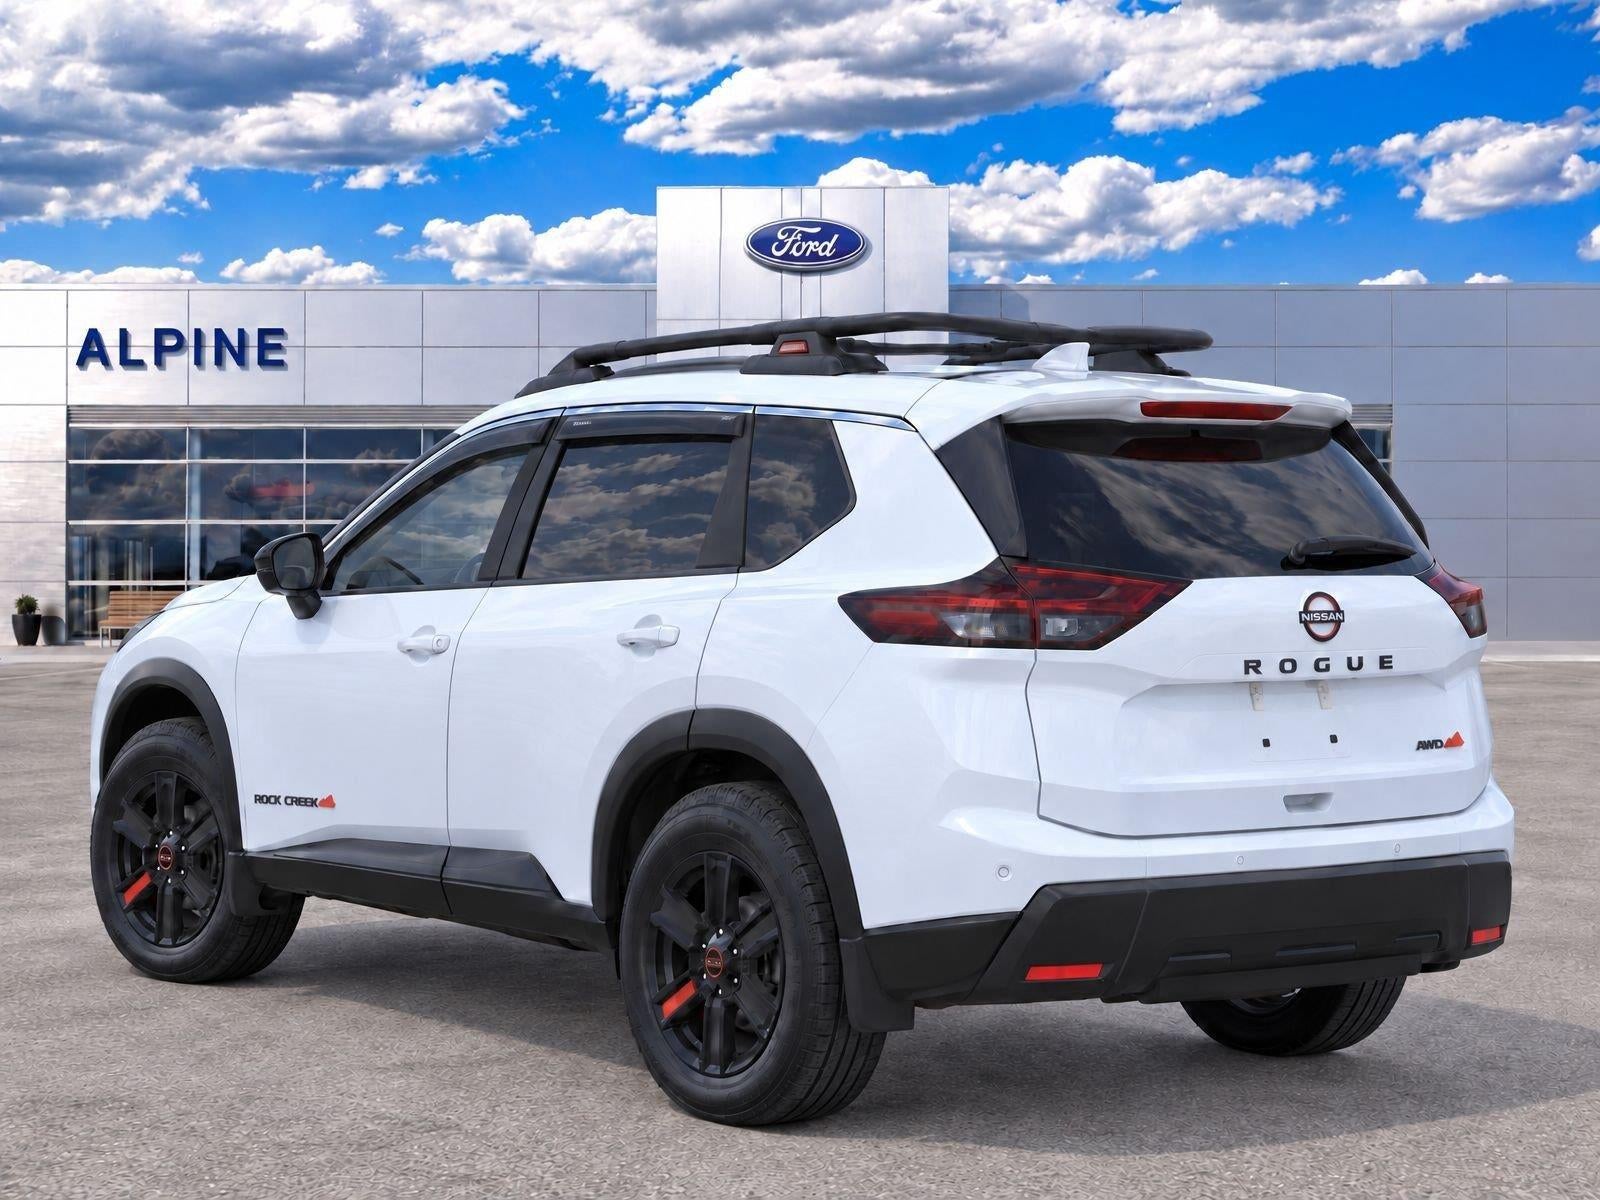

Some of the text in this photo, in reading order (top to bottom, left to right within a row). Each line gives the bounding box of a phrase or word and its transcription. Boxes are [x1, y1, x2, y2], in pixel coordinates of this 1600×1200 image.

[771, 225, 839, 257] Ford
[76, 327, 287, 369] ALPINE
[1301, 612, 1343, 621] NISSAN
[1243, 655, 1394, 675] ROGUE
[1415, 739, 1444, 751] AWD
[254, 794, 318, 808] ROCK CREEK
